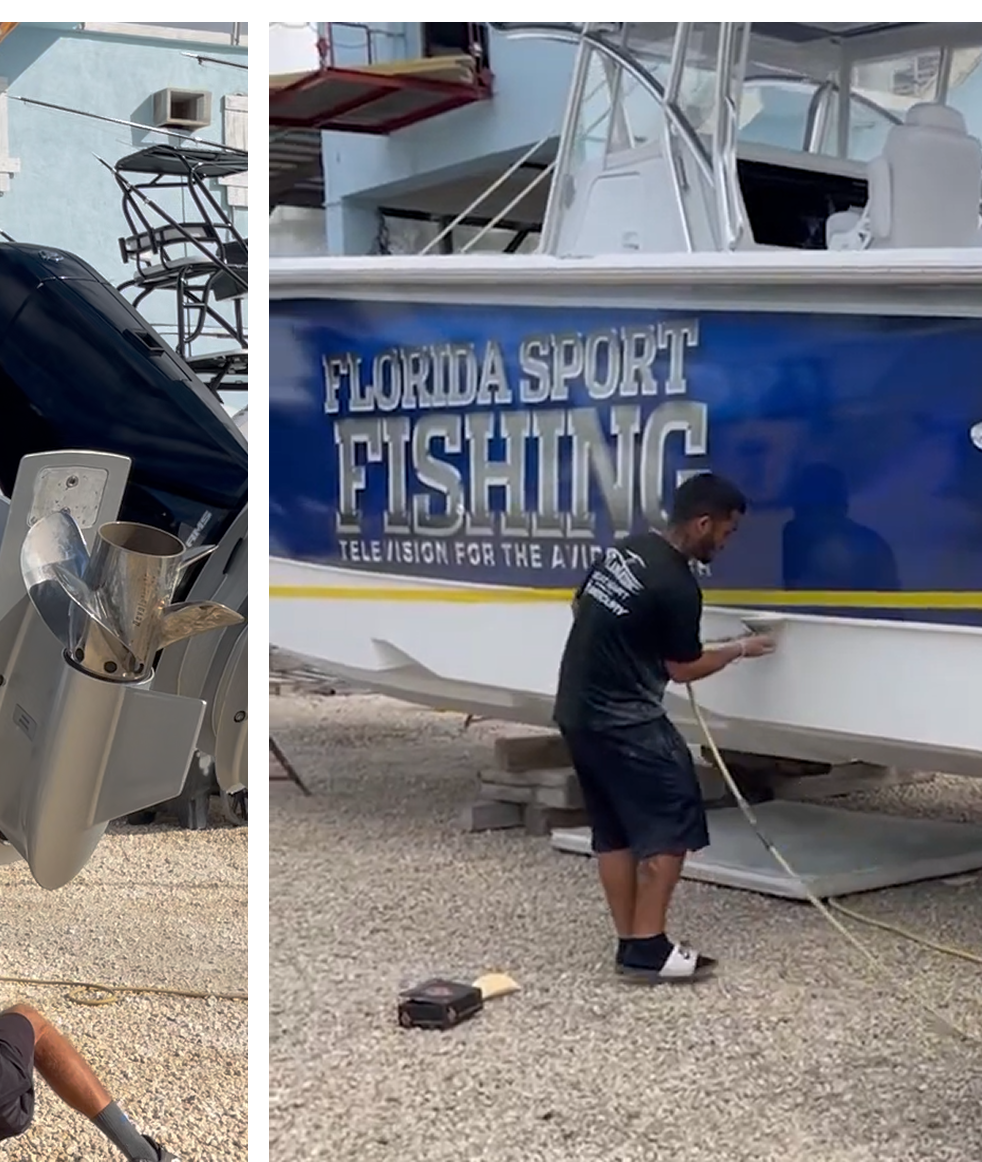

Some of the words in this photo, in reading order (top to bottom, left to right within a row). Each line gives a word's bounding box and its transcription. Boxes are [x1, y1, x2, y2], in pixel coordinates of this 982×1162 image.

[323, 341, 513, 414] FLORIDA
[520, 319, 699, 403] SPORT
[334, 401, 711, 539] FISHING
[339, 540, 449, 565] TELEVISION
[455, 542, 496, 567] FOR
[501, 543, 543, 569] THE
